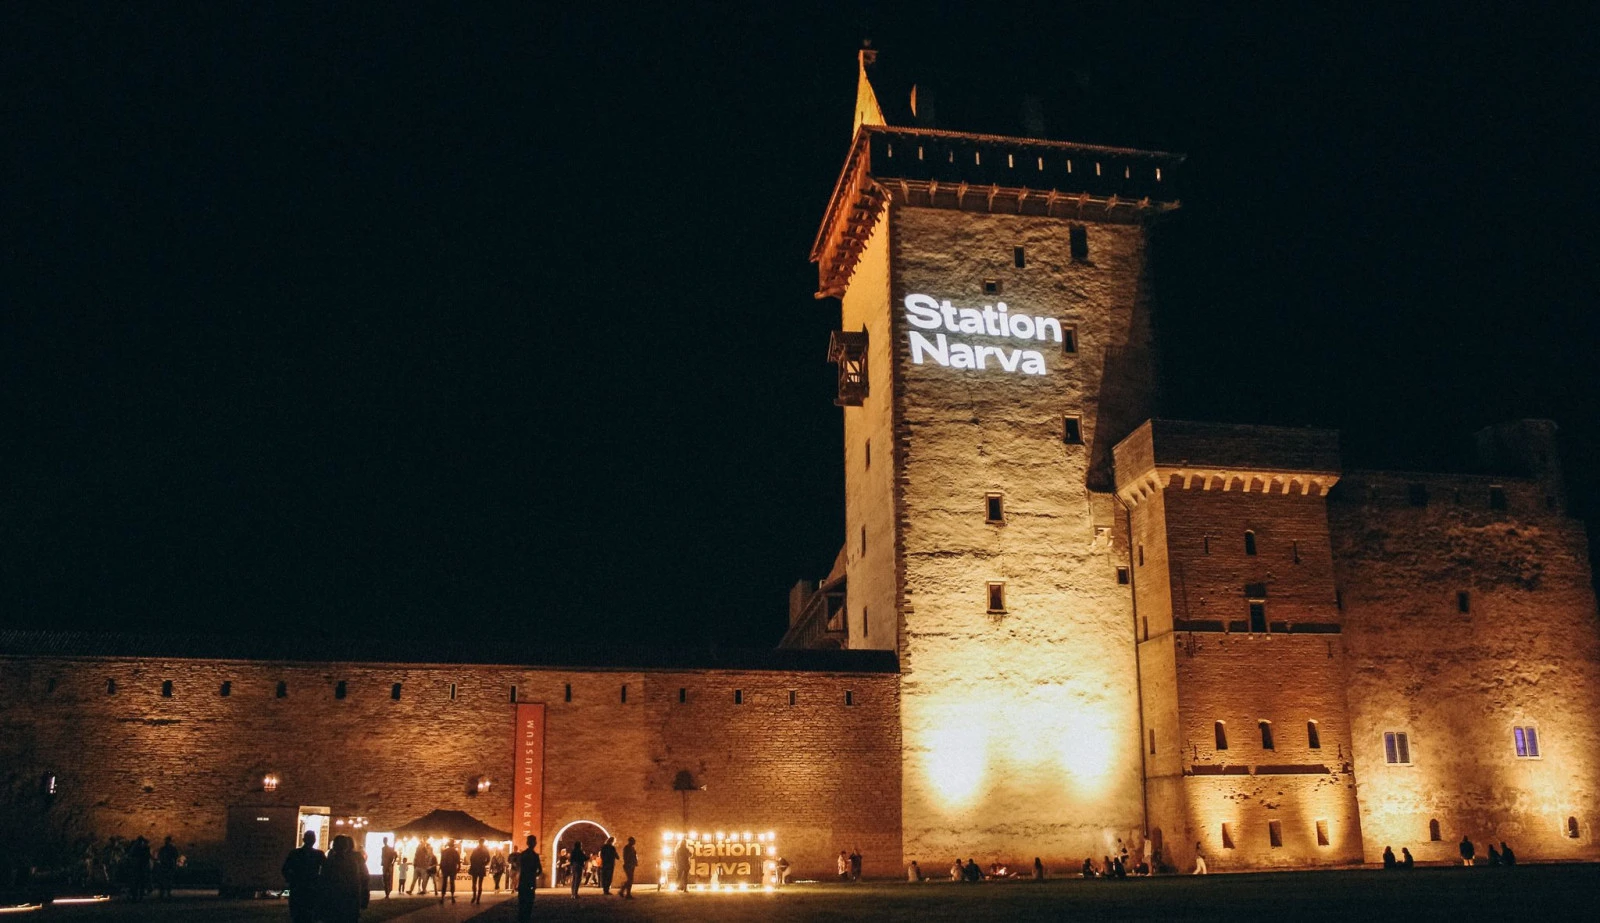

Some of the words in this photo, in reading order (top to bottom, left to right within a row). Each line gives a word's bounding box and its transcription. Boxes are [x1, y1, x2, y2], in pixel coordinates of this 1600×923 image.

[904, 293, 1063, 343] Station
[909, 331, 1047, 375] Narva
[525, 719, 535, 785] MUUSEUM
[523, 793, 532, 837] NARVA
